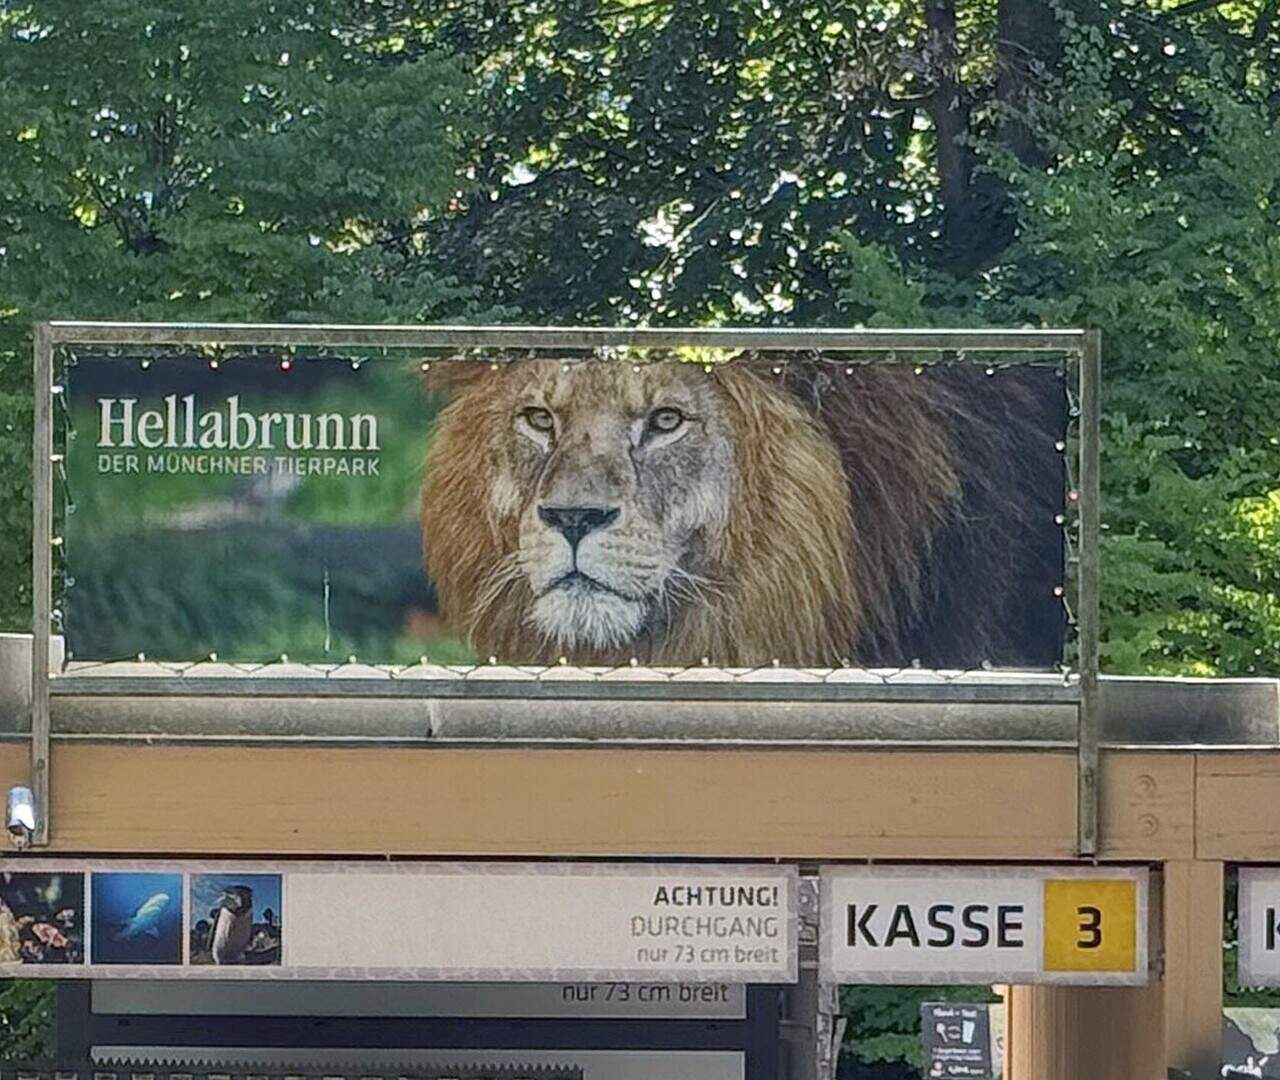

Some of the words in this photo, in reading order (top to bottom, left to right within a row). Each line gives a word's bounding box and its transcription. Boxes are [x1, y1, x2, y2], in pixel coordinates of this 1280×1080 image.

[96, 394, 380, 450] Hellabrunn
[97, 454, 139, 473] DER
[147, 453, 267, 475] MÜNCHNER
[275, 456, 380, 476] TIERPARK
[654, 886, 779, 907] ACHTUNG!
[631, 916, 778, 937] DURCHGANG
[848, 904, 1024, 949] KASSE
[1077, 909, 1104, 949] 3
[637, 950, 668, 962] nur
[675, 946, 695, 963] 73
[700, 950, 729, 963] cm
[735, 946, 779, 963] breit
[562, 986, 598, 1001] nur
[604, 983, 629, 1001] 73
[638, 986, 670, 1001] cm
[679, 983, 728, 1002] breit
